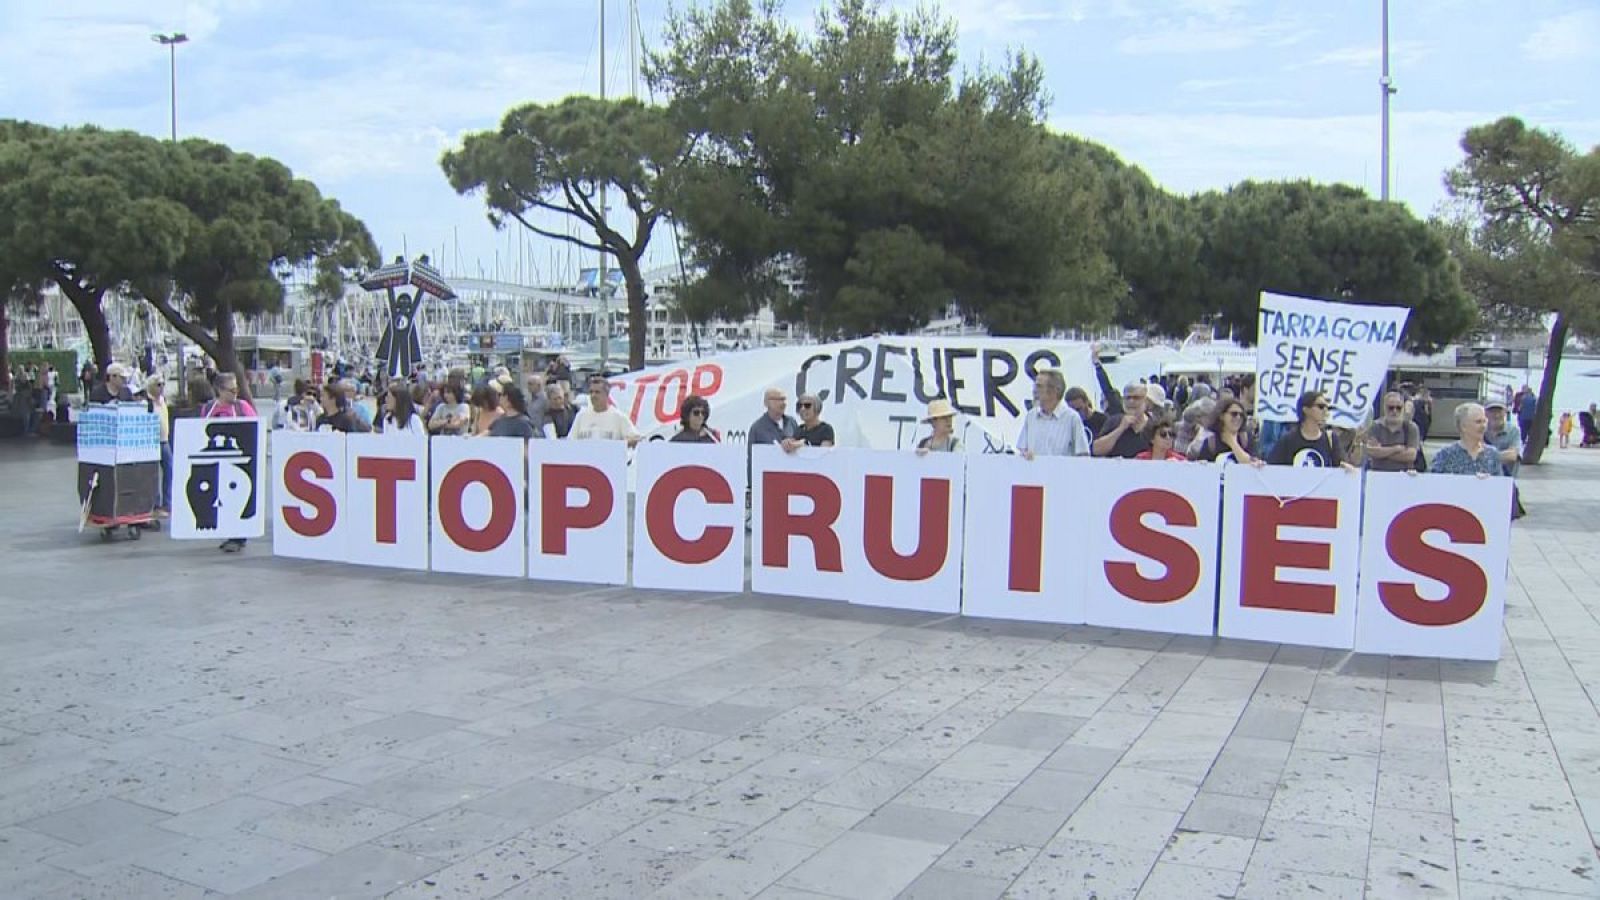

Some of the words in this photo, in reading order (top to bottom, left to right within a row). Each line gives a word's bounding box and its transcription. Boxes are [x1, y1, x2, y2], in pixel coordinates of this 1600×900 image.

[1260, 308, 1397, 346] TARRAGONA
[1275, 342, 1357, 378] SENSE
[1260, 370, 1369, 410] CREUERS
[283, 451, 612, 554] STOP
[646, 468, 1487, 626] CRUISES
